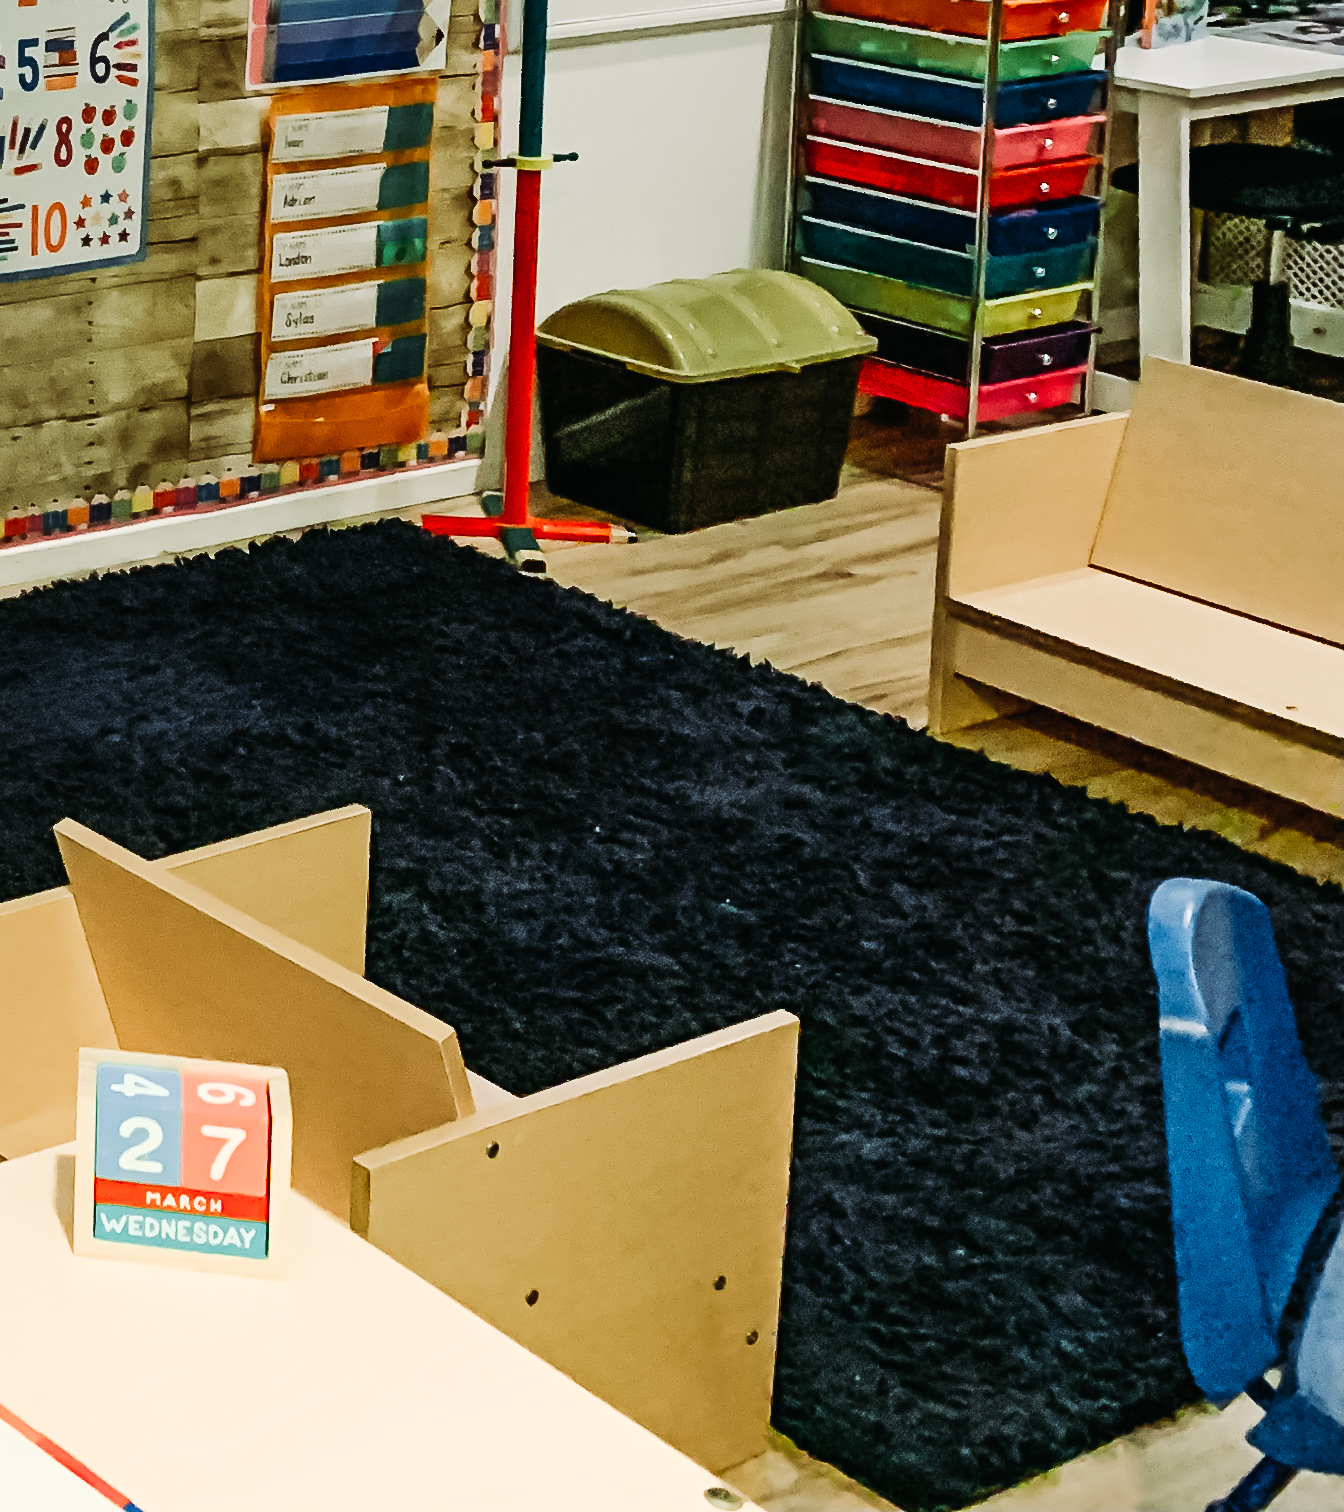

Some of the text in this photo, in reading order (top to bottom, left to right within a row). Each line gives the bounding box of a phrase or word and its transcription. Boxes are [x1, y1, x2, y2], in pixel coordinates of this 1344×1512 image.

[17, 36, 40, 93] 5
[89, 30, 112, 85] 6
[53, 115, 74, 168] 8
[29, 200, 68, 257] 10
[145, 1190, 223, 1214] MARCH
[99, 1211, 257, 1249] WEDNESDAY
